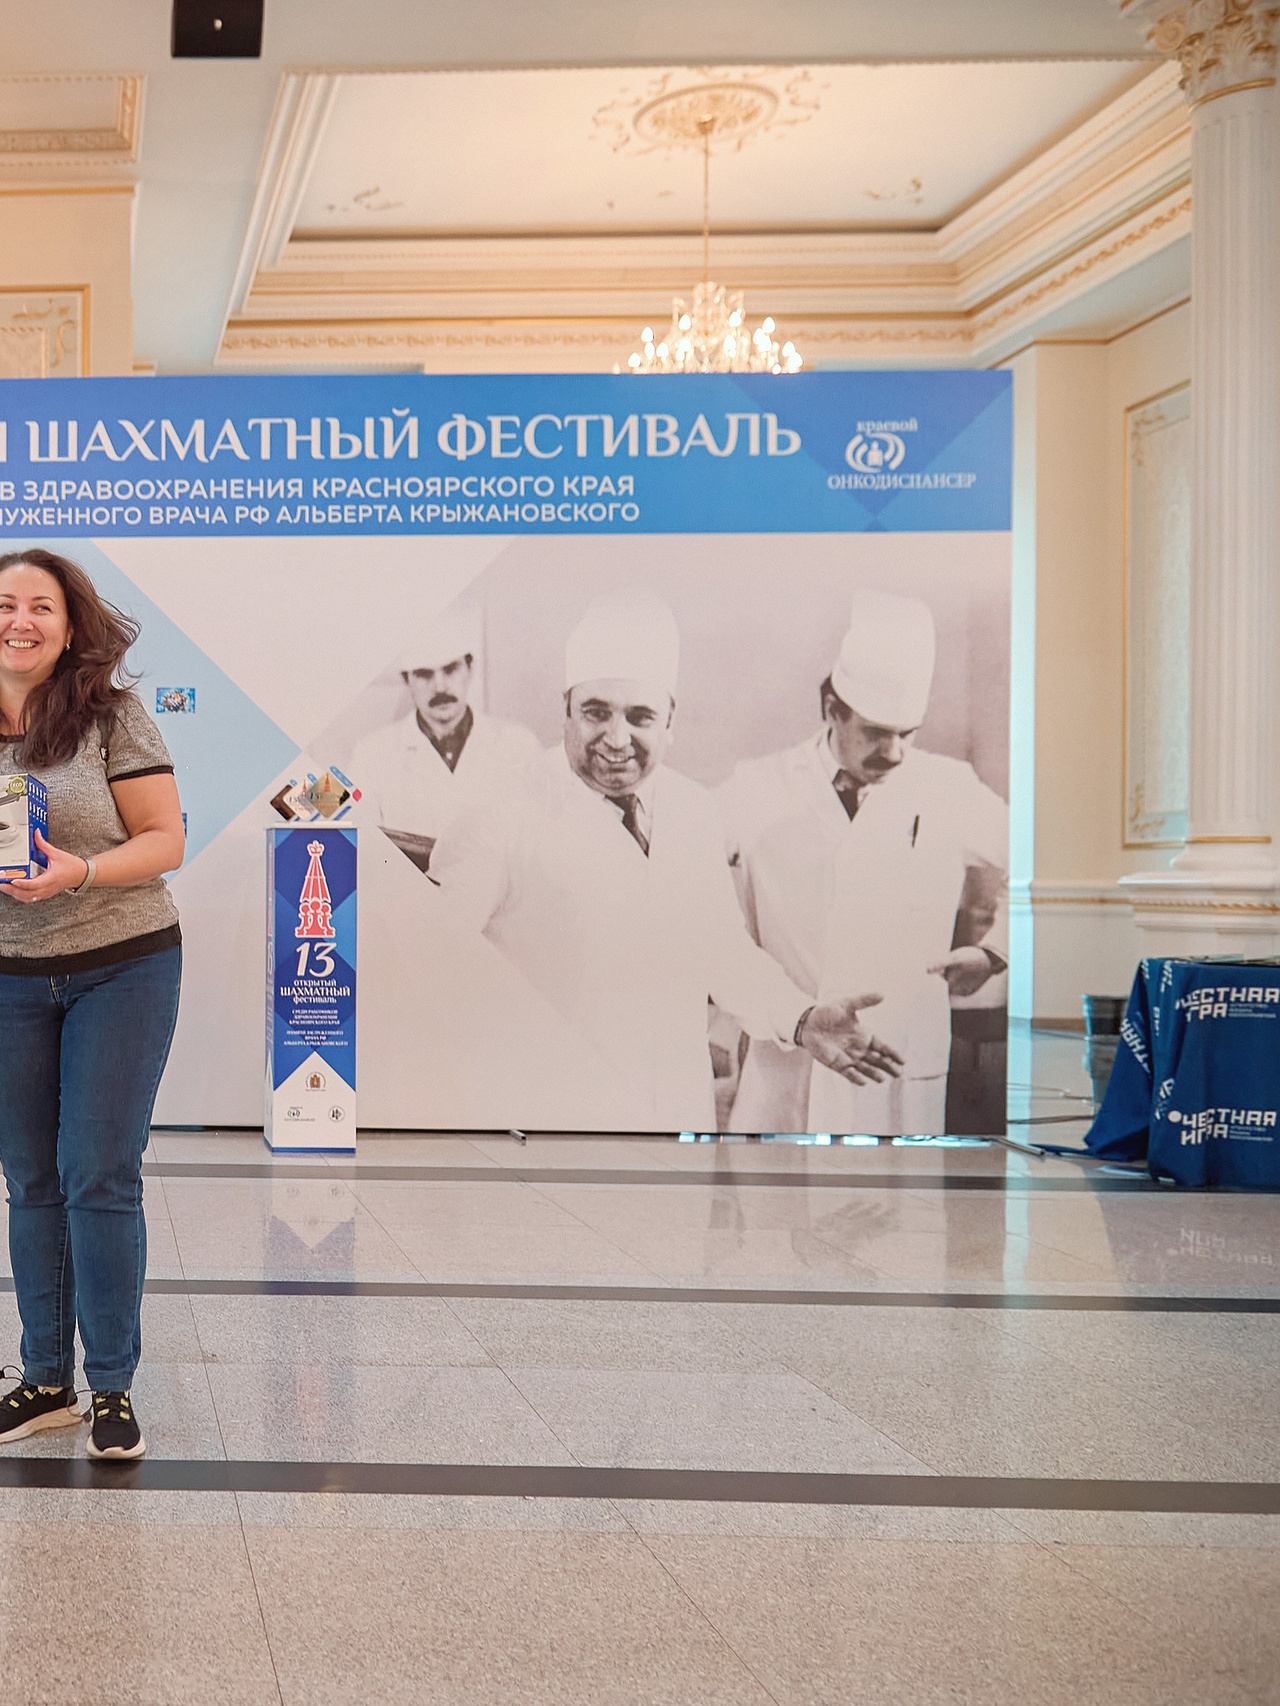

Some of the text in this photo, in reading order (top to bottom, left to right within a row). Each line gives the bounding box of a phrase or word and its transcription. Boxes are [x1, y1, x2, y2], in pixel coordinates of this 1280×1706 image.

[25, 408, 419, 464] ШАХМАТНЫЙ
[437, 413, 802, 461] ФЕСТИВАЛЬ
[23, 478, 303, 504] ЗДРАВООХРАНЕНИЯ
[312, 476, 555, 499] КРАСНОЯРСКОГО
[563, 475, 635, 497] КРАЯ
[826, 472, 977, 491] ОНКОДИСПАНСЕР
[149, 506, 228, 525] ВРАЧА
[234, 504, 270, 526] РФ
[276, 504, 404, 525] АЛЬБЕРТА
[410, 502, 641, 524] КРЫЖАНОВСКОГО
[296, 942, 337, 977] 13
[280, 986, 351, 997] ШАХМАТНЫЙ
[1181, 1108, 1277, 1129] ЧЕСТНАЯ
[1180, 1124, 1228, 1146] ИГРА
